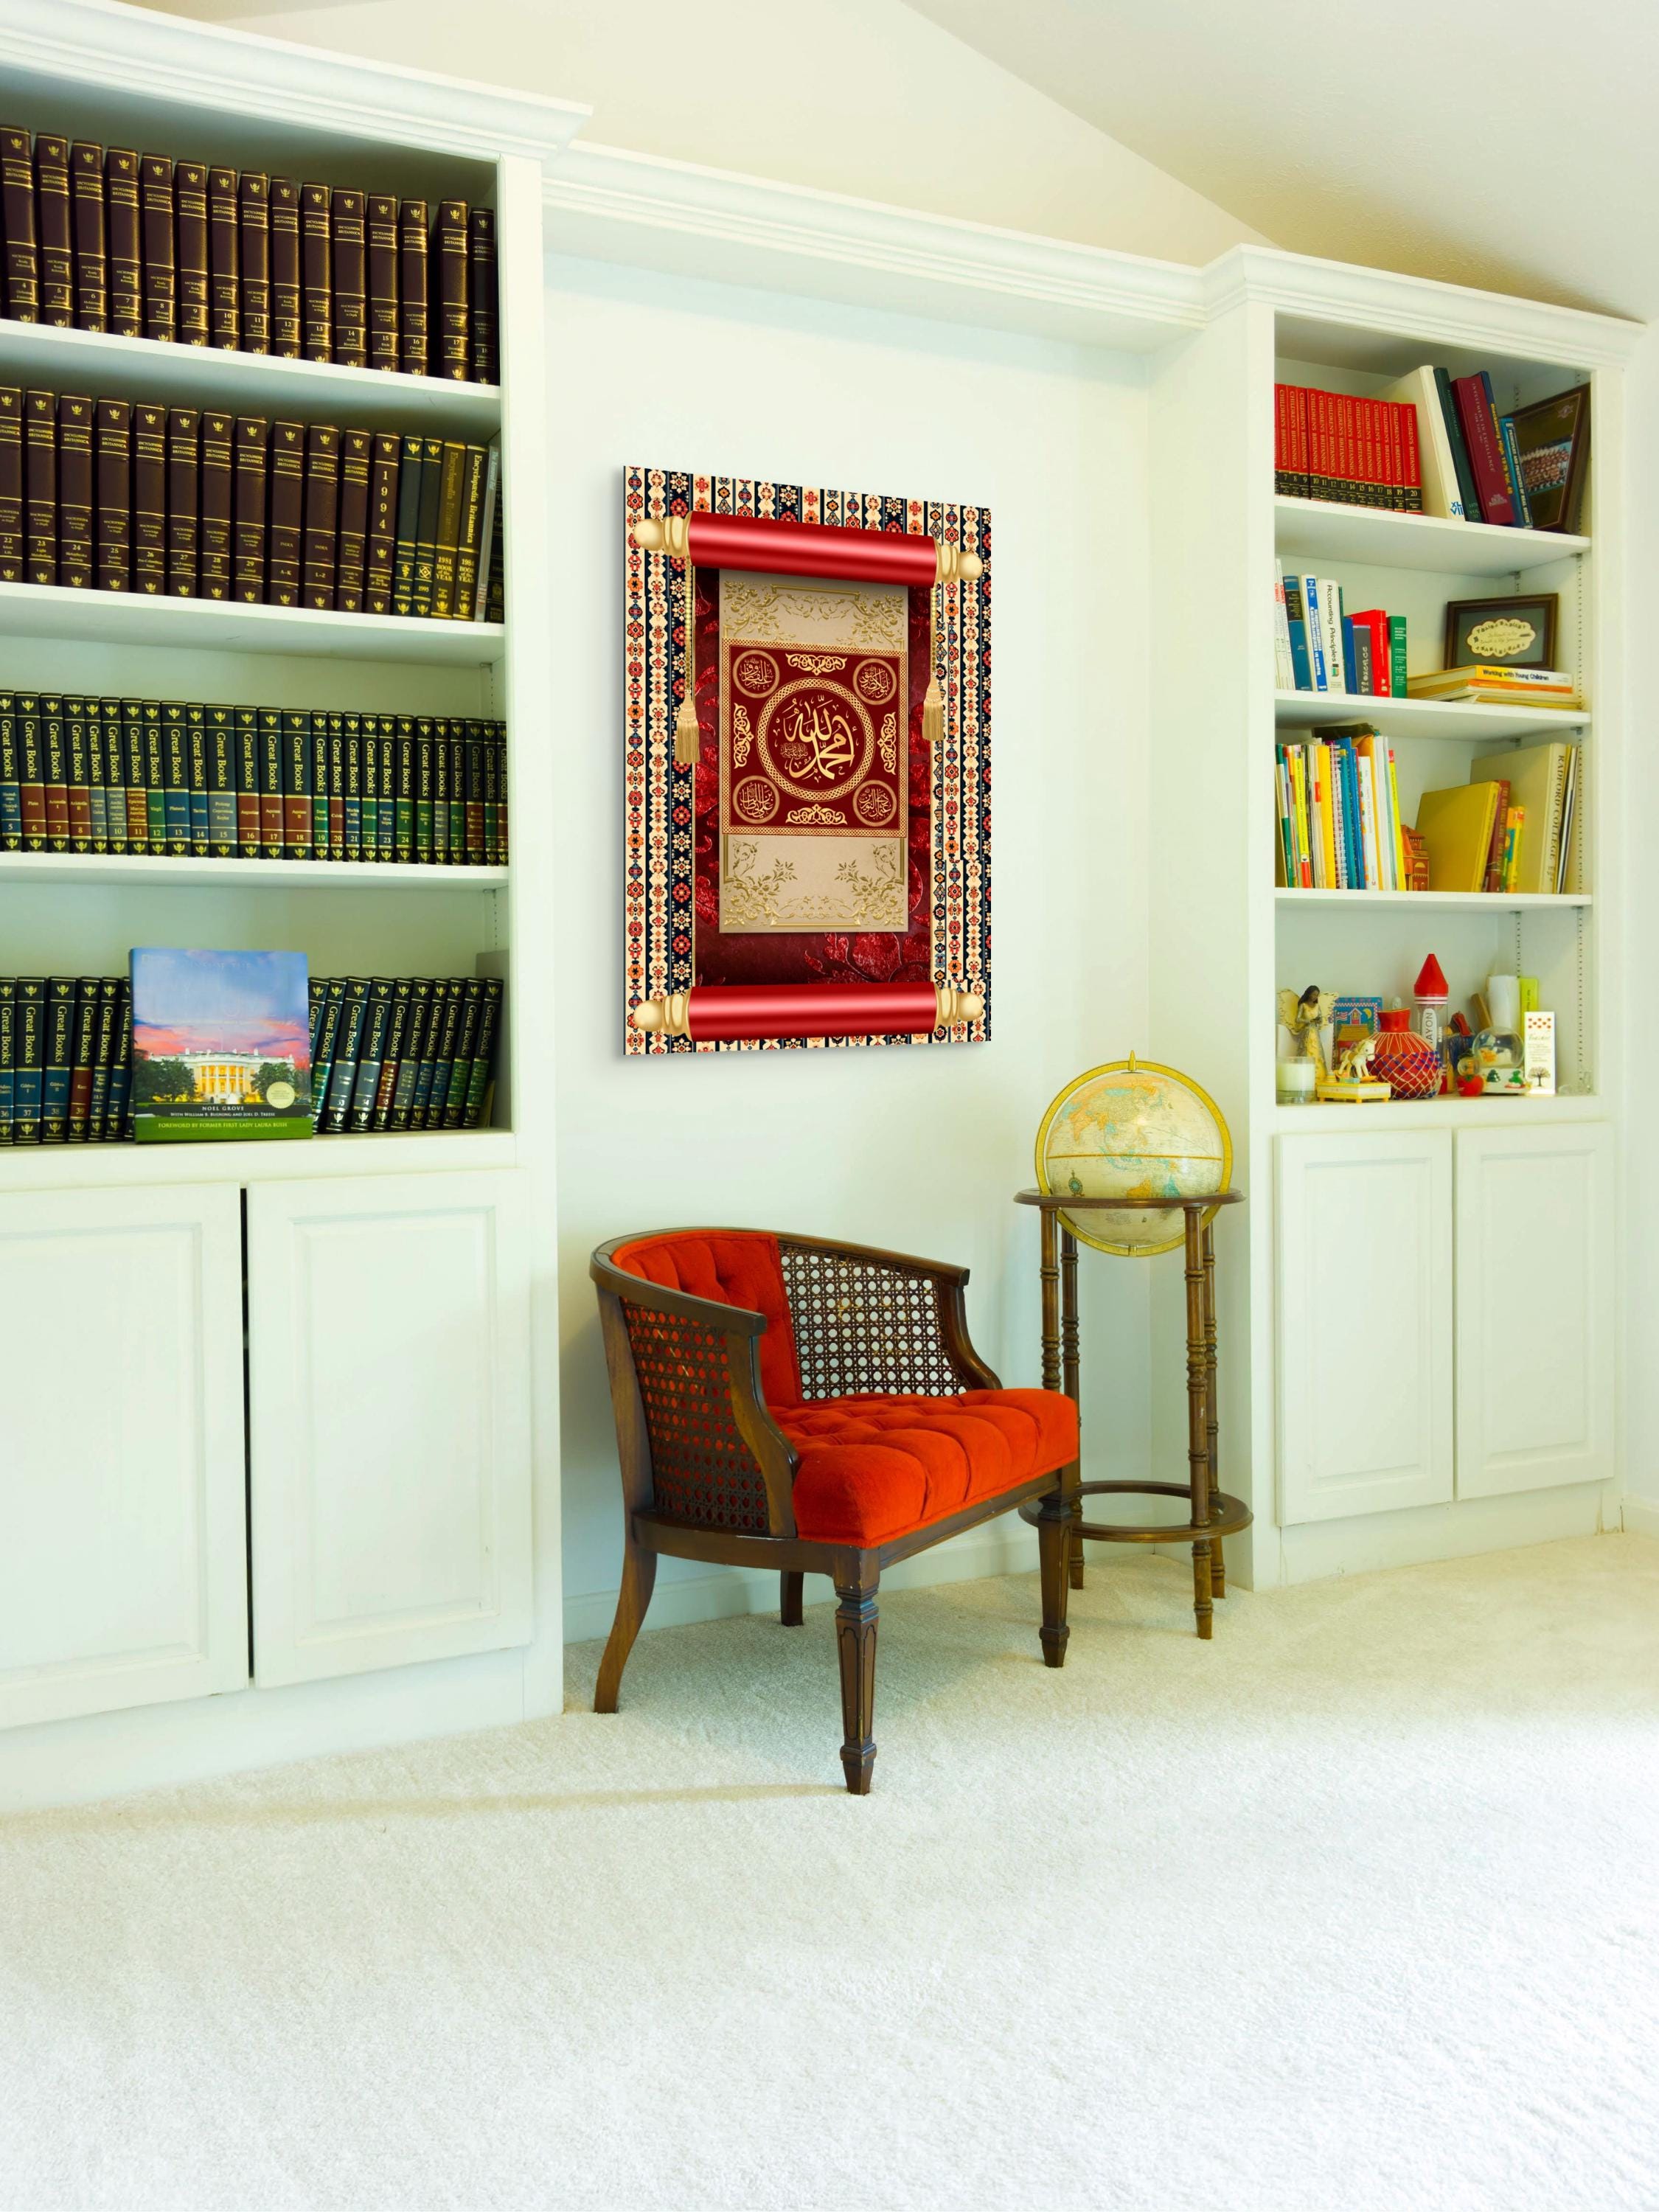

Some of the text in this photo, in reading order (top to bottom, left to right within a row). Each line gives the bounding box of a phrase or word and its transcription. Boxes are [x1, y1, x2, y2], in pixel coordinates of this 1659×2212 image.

[467, 505, 478, 543] Britannica
[436, 574, 452, 582] YEAR
[437, 564, 452, 572] BOOK
[1327, 585, 1338, 662] Accounting Principles
[1483, 669, 1502, 678] Working
[1, 720, 13, 778] Great Books
[25, 721, 36, 779] Great Books
[49, 723, 61, 780] Great Books
[72, 725, 83, 782] Great Books
[90, 726, 102, 782] Great Books
[108, 726, 119, 783] Great Books
[130, 728, 142, 784] Great Books
[149, 729, 160, 785] Great Books
[171, 728, 181, 785] Great Books
[192, 731, 204, 787] Great Books
[216, 732, 226, 787] Great Books
[243, 734, 254, 789] Great Books
[268, 735, 278, 790] Great Books
[293, 737, 304, 791] Great Books
[316, 739, 326, 792] Great Books
[349, 740, 358, 794] Great Books
[383, 742, 392, 795] Great Books
[403, 742, 411, 795] Great Books
[1, 1007, 12, 1065] Great Books
[25, 1007, 35, 1064] Great Books
[55, 1006, 67, 1062] Great Books
[321, 1006, 338, 1059] Great Books
[345, 1005, 361, 1057] Great Books
[369, 1006, 385, 1057] Great Books
